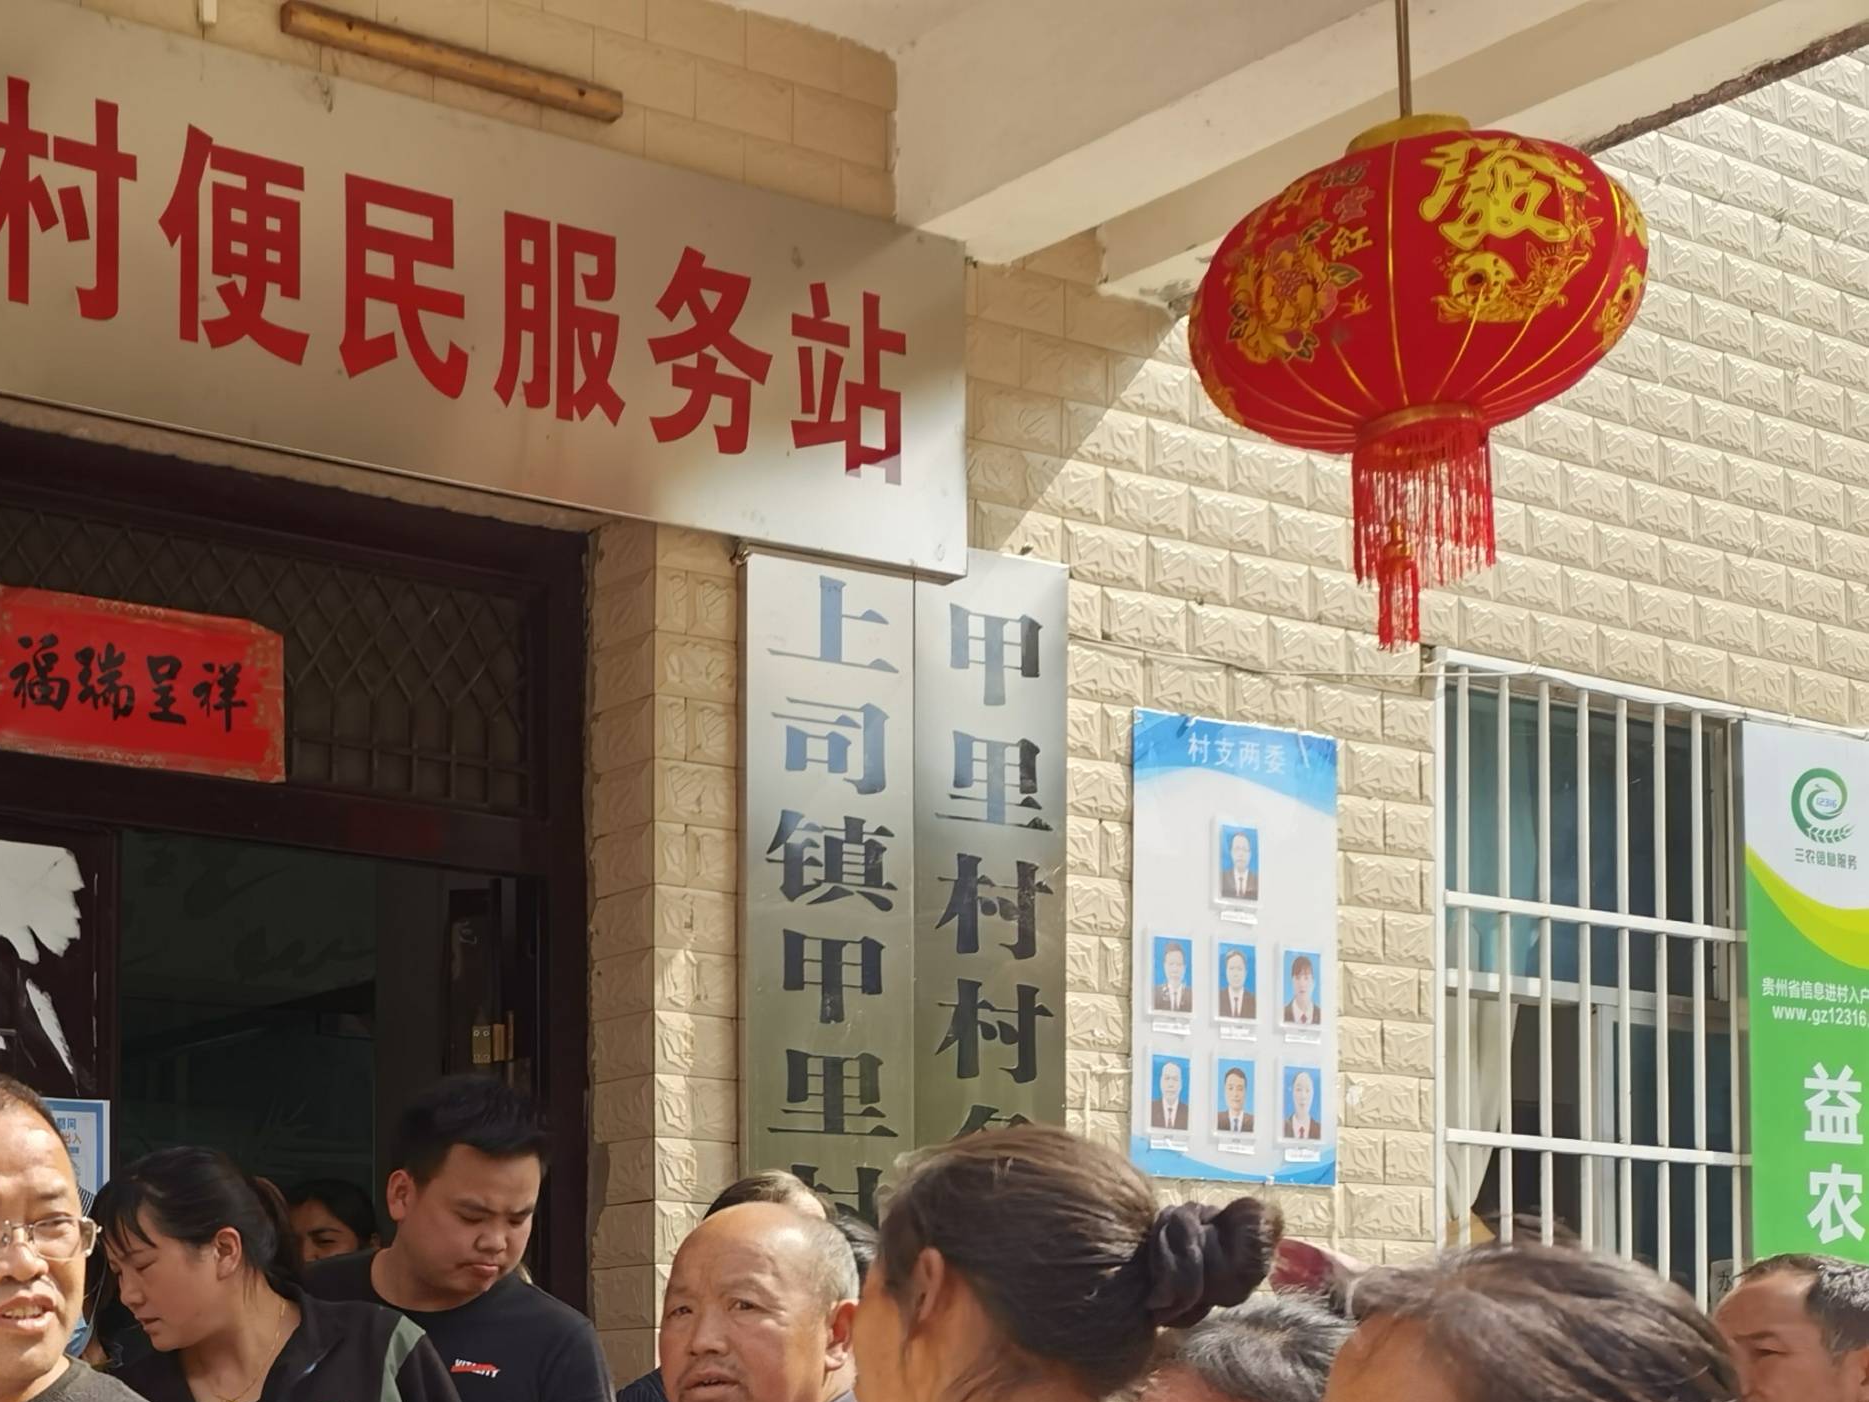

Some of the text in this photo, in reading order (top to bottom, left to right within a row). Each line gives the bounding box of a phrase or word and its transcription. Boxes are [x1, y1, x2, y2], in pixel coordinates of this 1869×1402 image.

[8, 633, 248, 733] 福瑞呈祥
[1187, 731, 1287, 775] 村支两委
[1803, 1061, 1867, 1245] 益农
